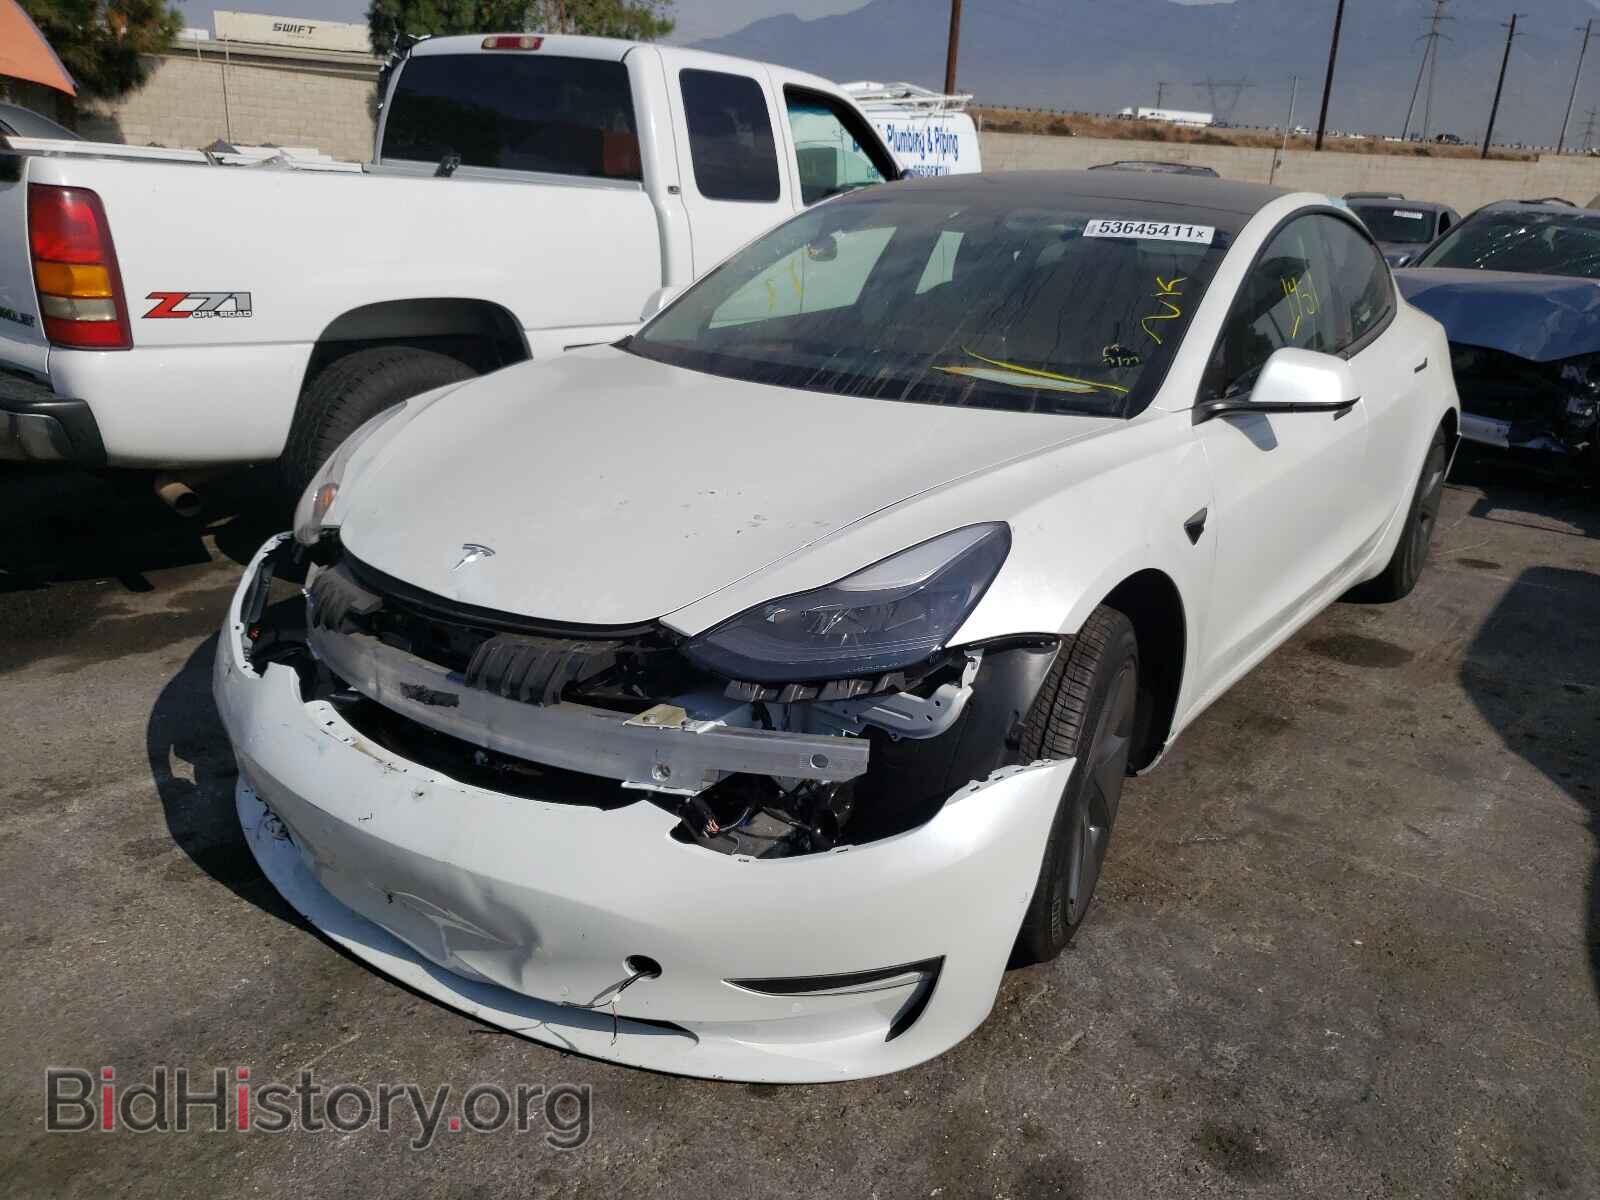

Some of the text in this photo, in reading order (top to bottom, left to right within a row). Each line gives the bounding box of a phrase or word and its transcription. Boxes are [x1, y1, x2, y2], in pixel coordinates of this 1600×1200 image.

[272, 22, 316, 35] SWIFT
[887, 123, 959, 161] Plumbing & Piping
[142, 291, 252, 319] Z71
